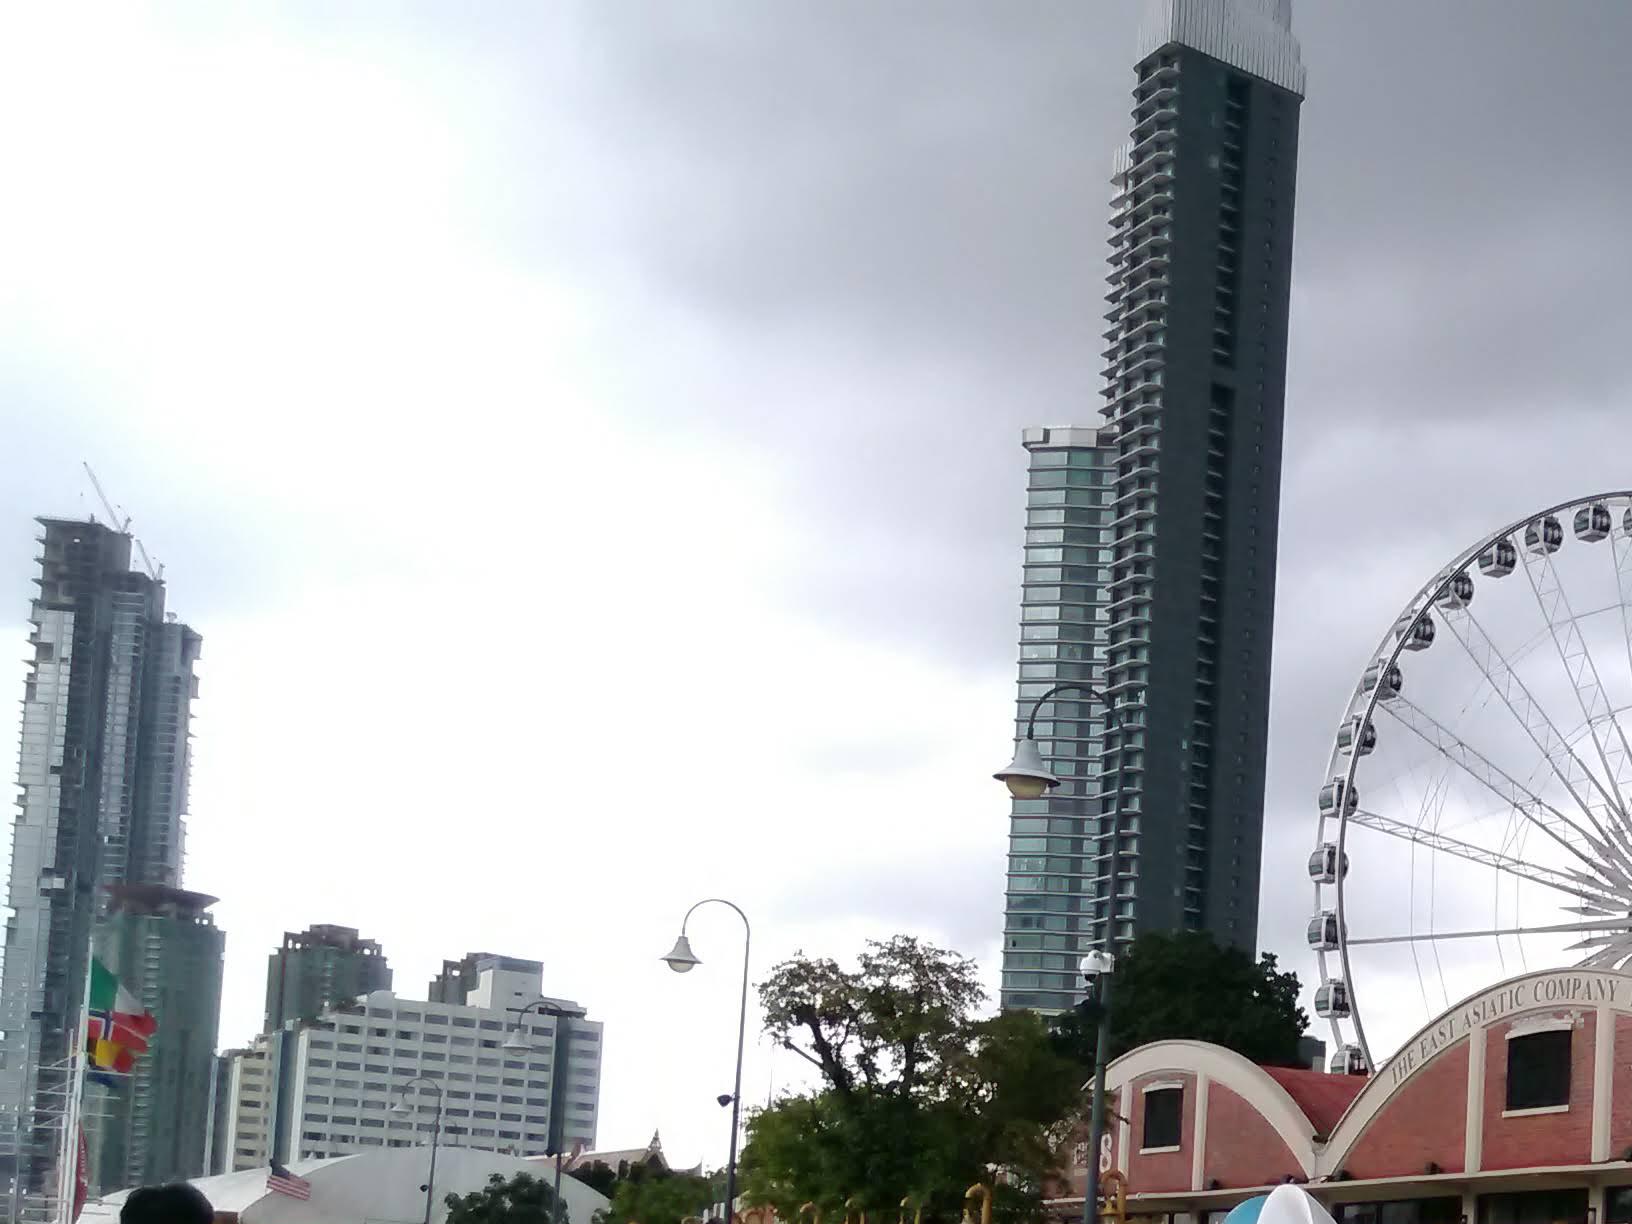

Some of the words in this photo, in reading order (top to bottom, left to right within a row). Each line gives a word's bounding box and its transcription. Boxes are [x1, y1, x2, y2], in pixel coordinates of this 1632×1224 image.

[1391, 1048, 1416, 1085] THE
[1419, 1017, 1456, 1058] EAST
[1462, 982, 1526, 1029] ASIATIC
[1533, 976, 1619, 1003] COMPANY
